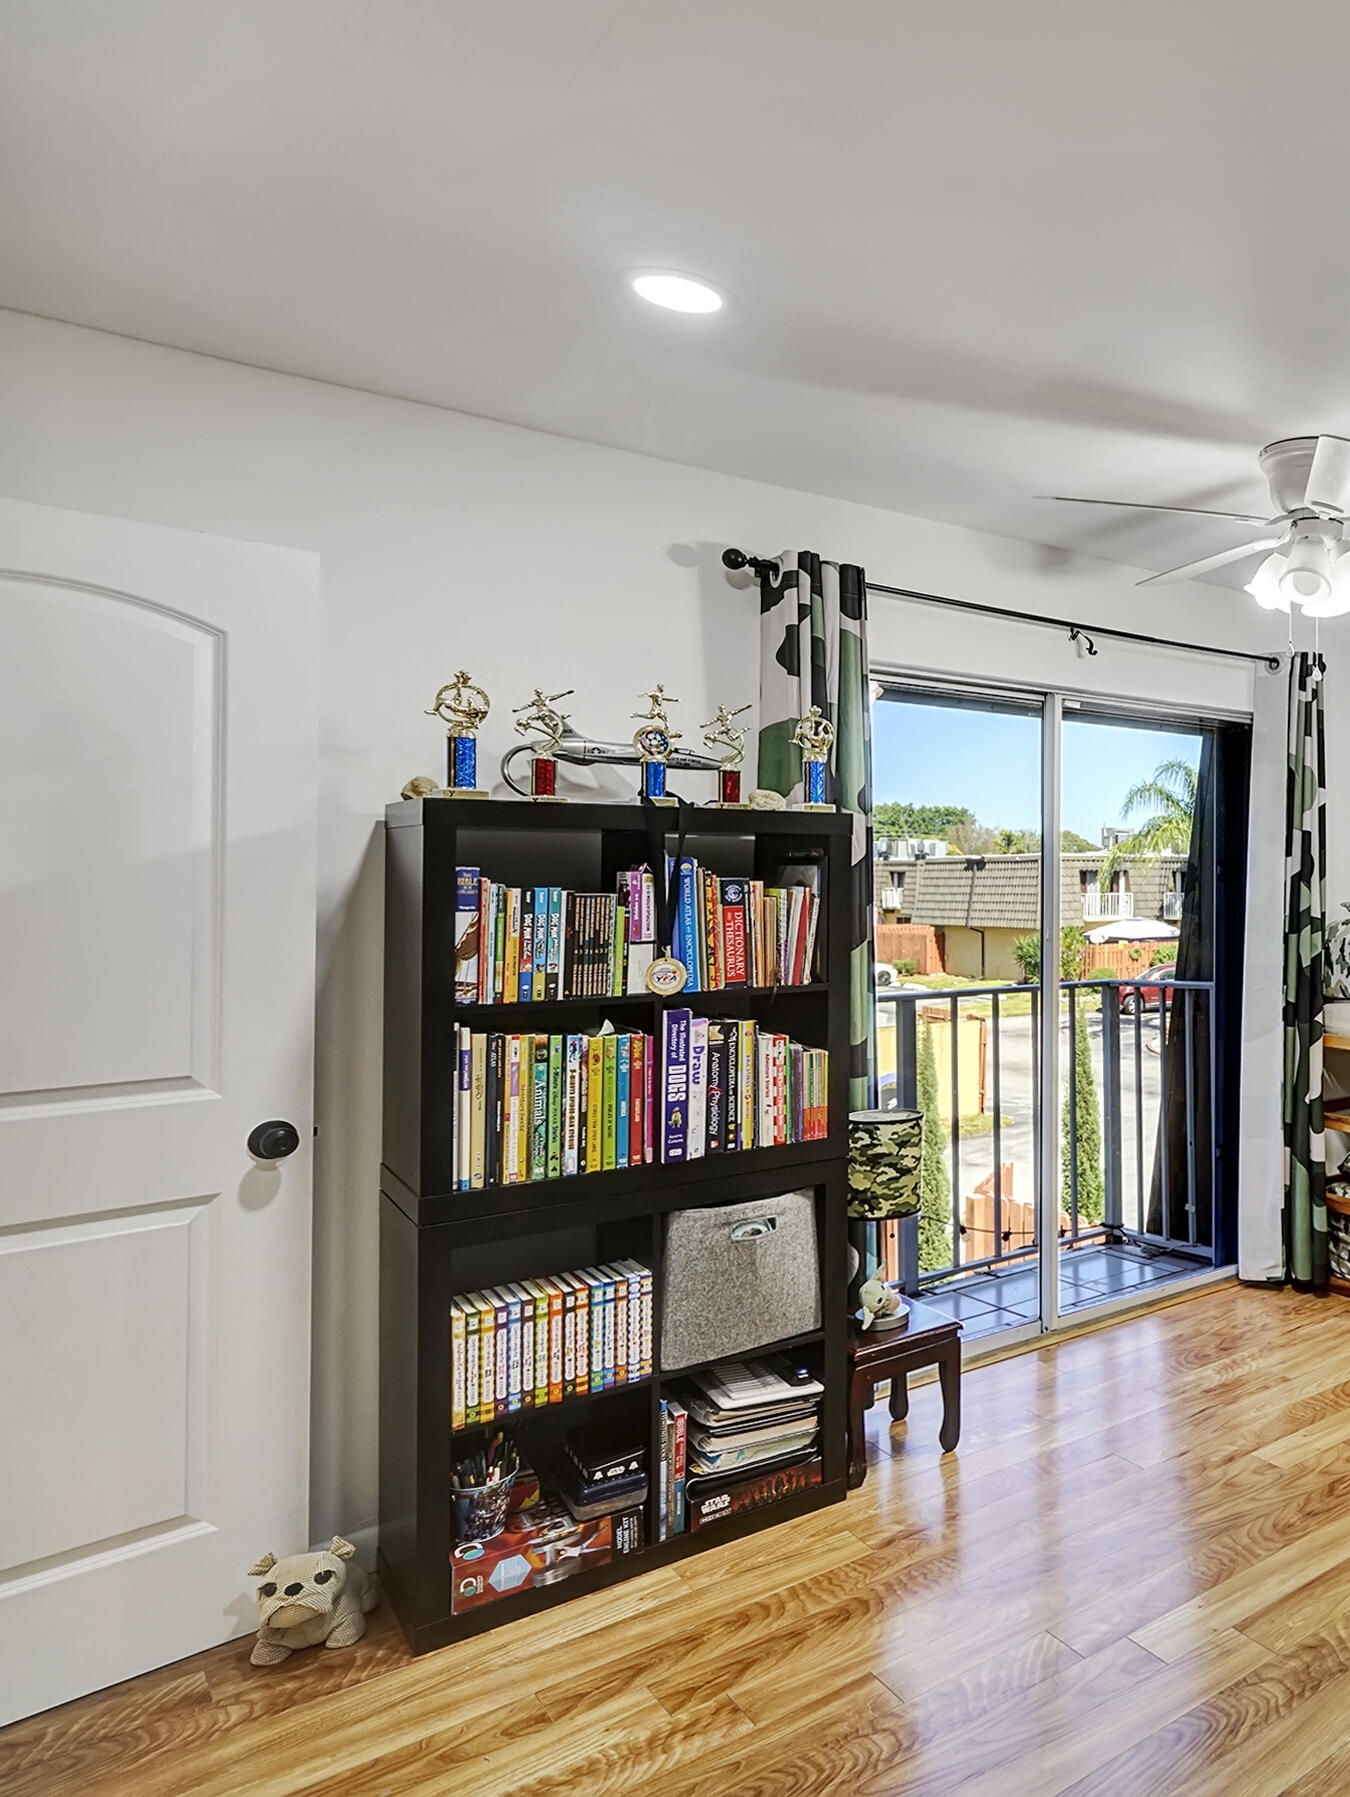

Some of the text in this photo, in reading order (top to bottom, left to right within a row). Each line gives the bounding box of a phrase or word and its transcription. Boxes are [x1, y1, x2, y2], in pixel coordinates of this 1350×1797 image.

[683, 877, 691, 904] WORLD
[684, 905, 692, 925] ATLAS
[685, 934, 694, 987] ENCYCLOPEDIA
[726, 921, 735, 977] THESAURUS
[734, 912, 744, 975] DICTIONARY
[670, 1024, 678, 1051] Directory
[668, 1065, 687, 1102] DOGS
[692, 1045, 705, 1085] Draw
[710, 1052, 720, 1089] Anatomy
[534, 1079, 546, 1124] Animals
[709, 1091, 720, 1135] Physiology
[728, 1096, 736, 1122] SCIENCE
[705, 1494, 731, 1506] STAR
